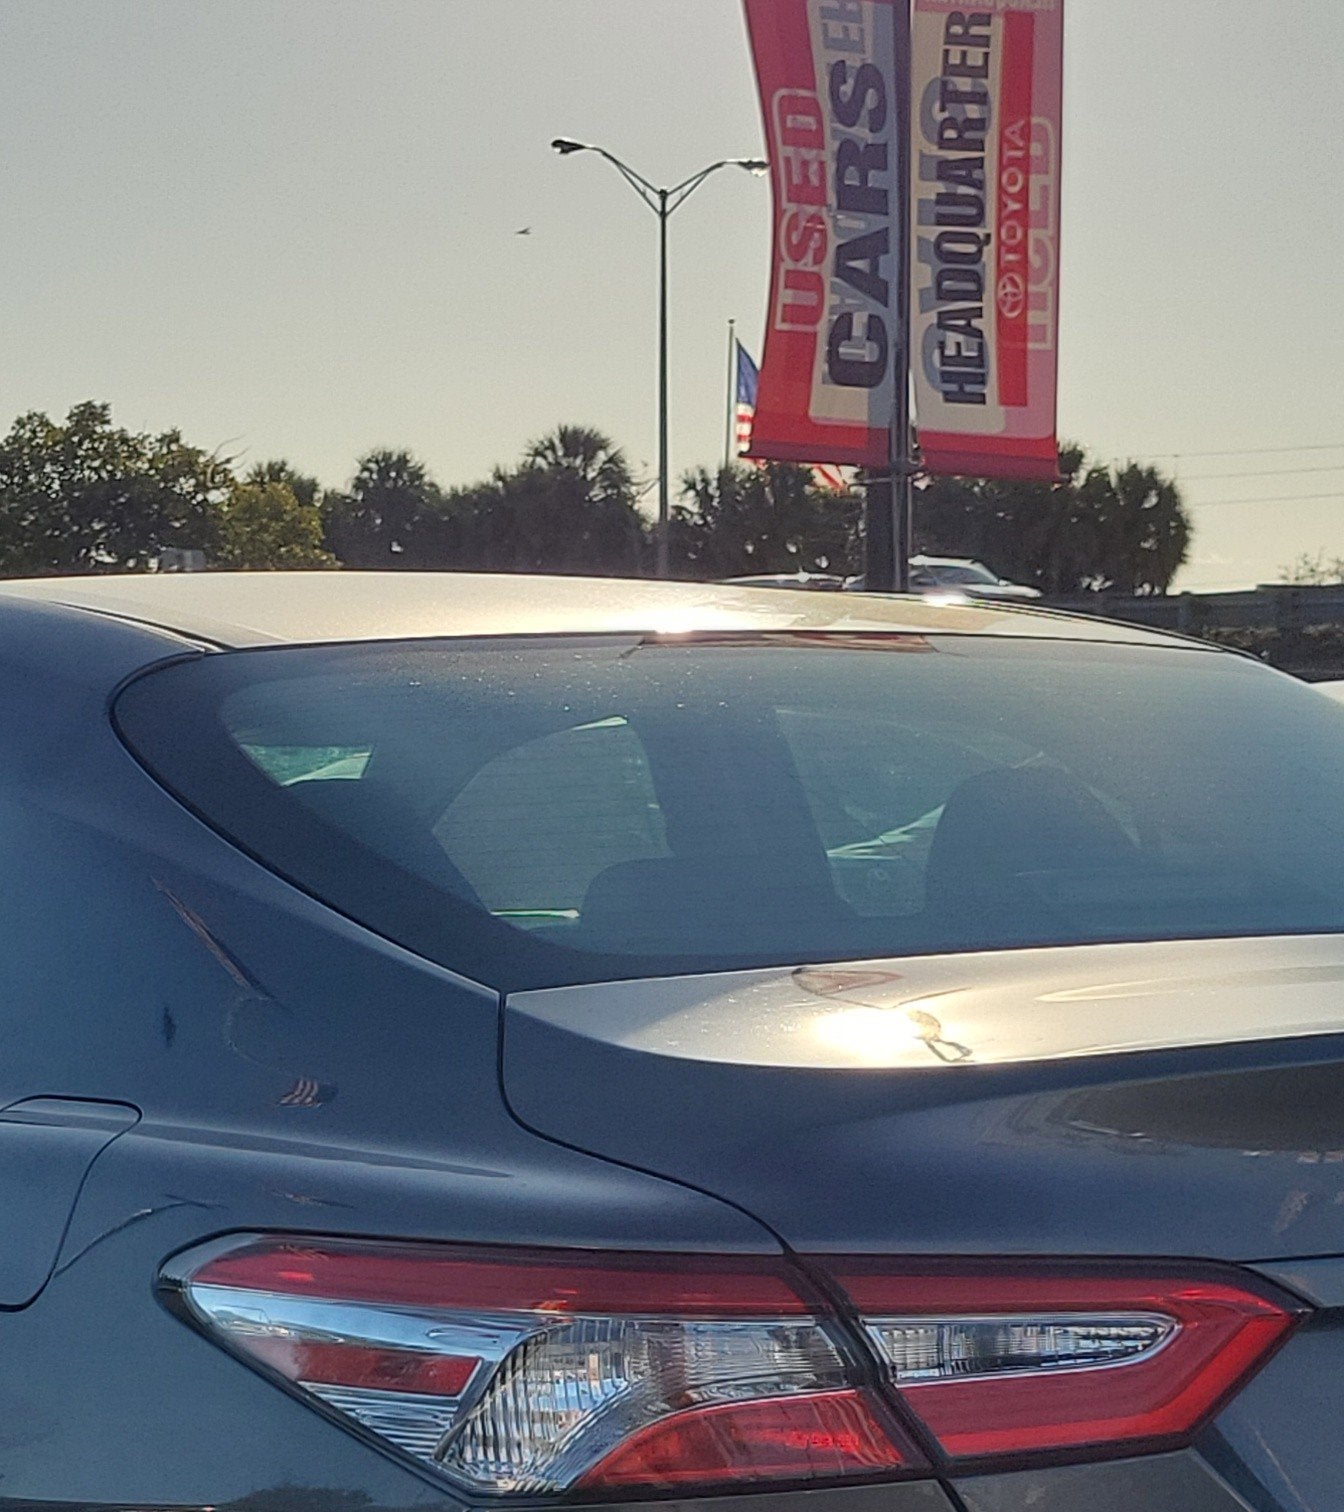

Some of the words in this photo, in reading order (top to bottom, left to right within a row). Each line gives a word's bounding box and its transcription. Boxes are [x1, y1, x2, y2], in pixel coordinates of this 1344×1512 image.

[773, 88, 828, 330] USED
[827, 58, 889, 388] CARS
[939, 11, 992, 405] HEADQUARTER
[1000, 118, 1026, 264] TOYOTA
